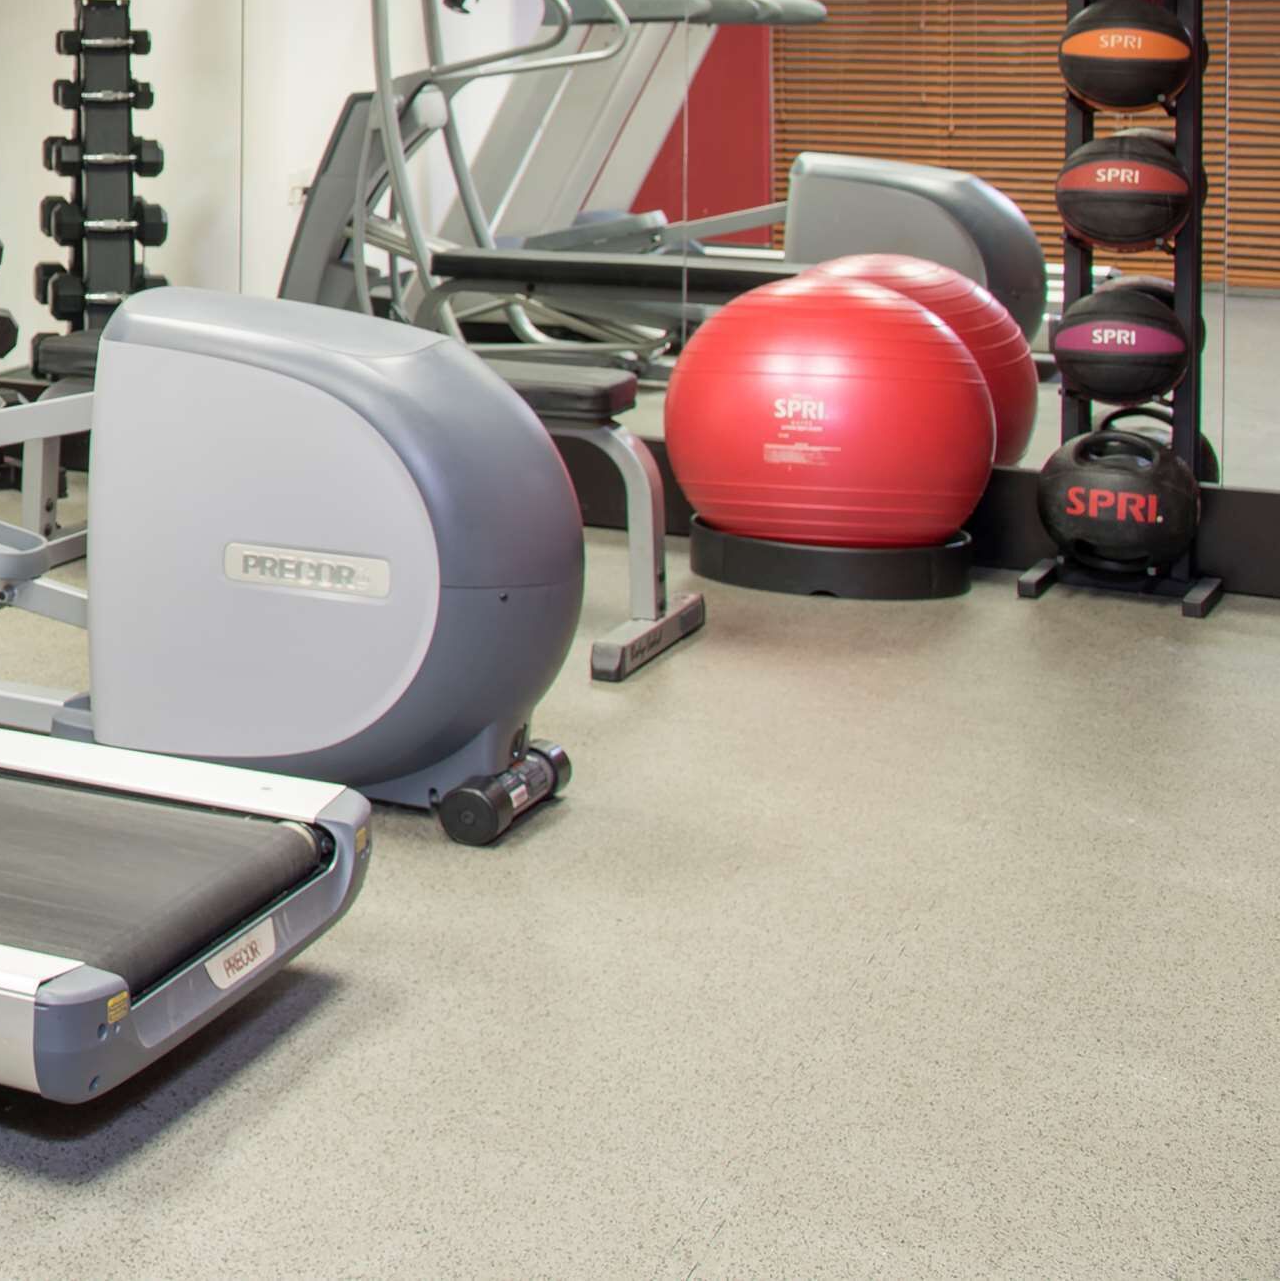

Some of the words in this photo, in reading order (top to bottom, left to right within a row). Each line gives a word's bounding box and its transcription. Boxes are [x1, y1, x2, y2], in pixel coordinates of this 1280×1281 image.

[1099, 34, 1143, 50] SPRI
[1095, 168, 1140, 184] SPRI
[1091, 329, 1136, 345] SPRI
[774, 399, 825, 420] SPRI
[242, 554, 356, 586] PRECOR
[222, 940, 261, 979] PRECOR
